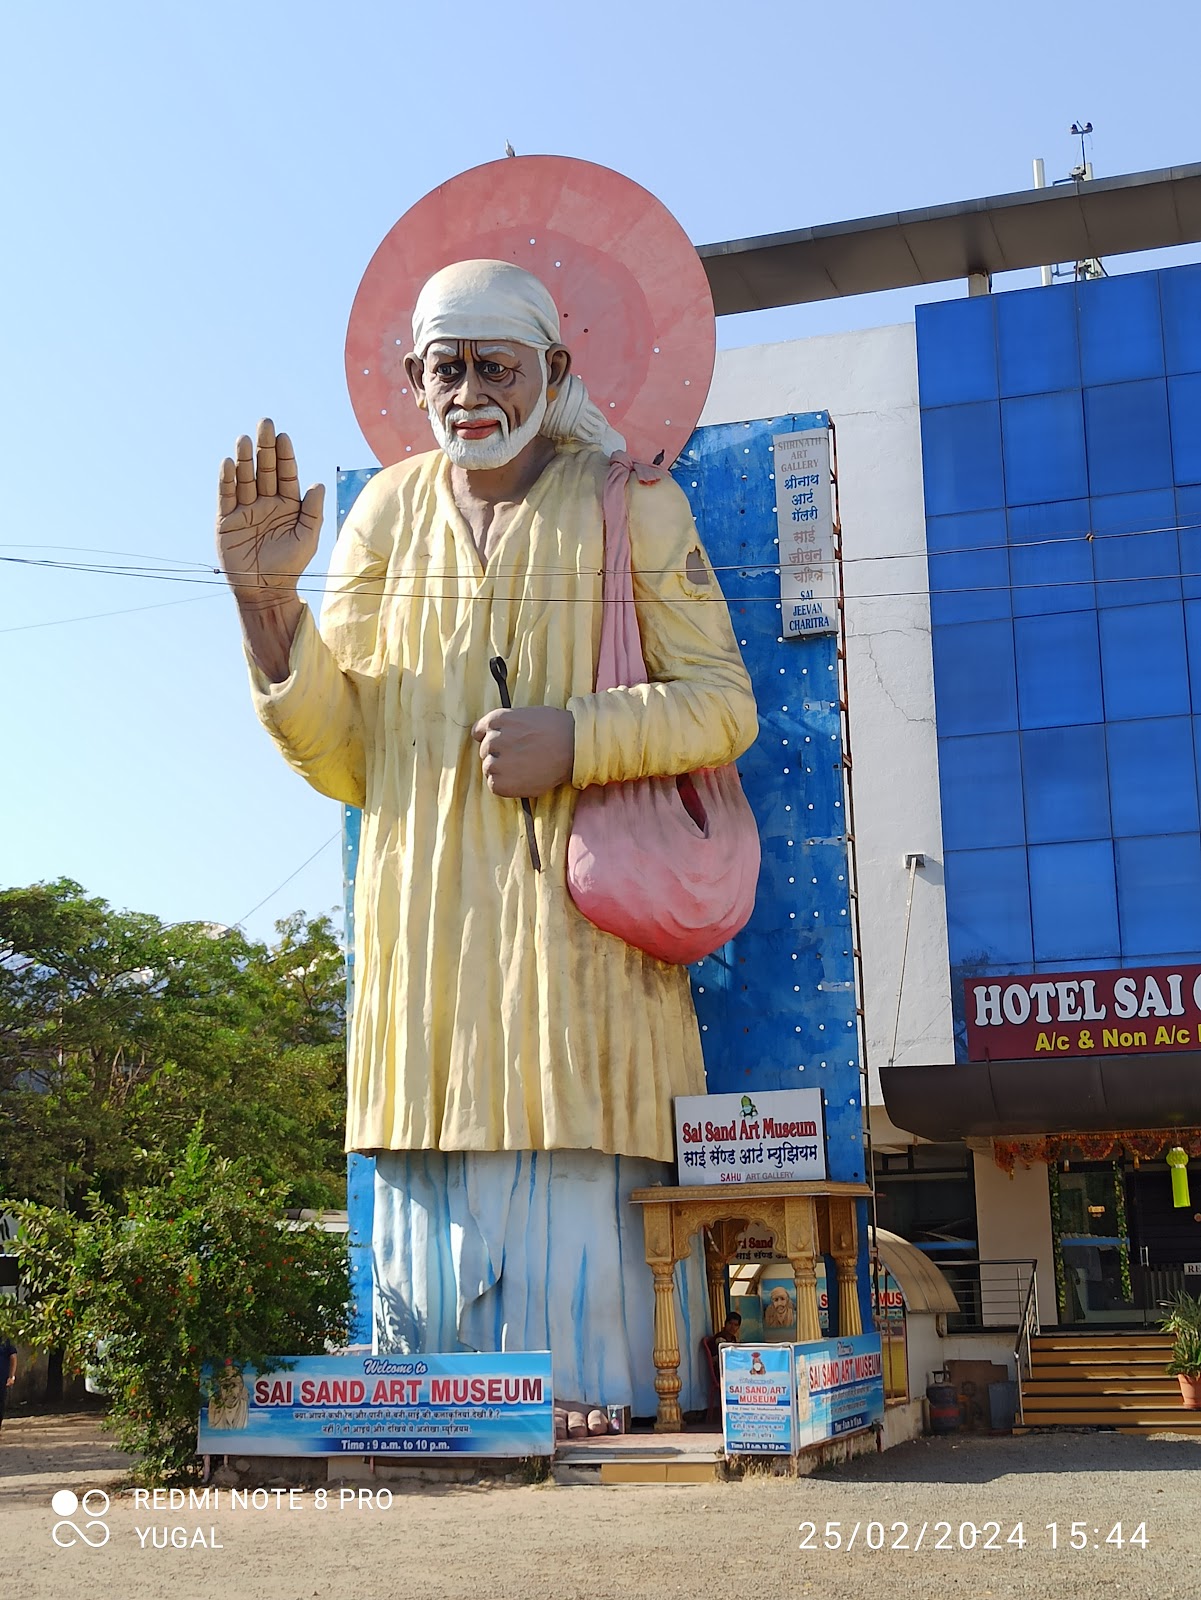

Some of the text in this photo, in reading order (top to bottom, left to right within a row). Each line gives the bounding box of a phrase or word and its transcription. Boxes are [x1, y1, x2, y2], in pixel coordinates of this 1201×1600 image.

[778, 437, 821, 451] SHRINATH
[791, 450, 808, 460] ART
[781, 459, 819, 472] GALLERY
[784, 474, 820, 490] श्रीनाथ
[791, 488, 814, 506] आर्ट
[793, 525, 816, 544] साई
[788, 548, 822, 564] जीवन
[800, 589, 814, 601] SAI
[793, 602, 823, 617] JEEVAN
[789, 616, 830, 631] CHARITRA
[973, 979, 1106, 1026] HOTEL
[1113, 974, 1185, 1019] SAI
[1034, 1031, 1070, 1051] A/c
[1077, 1029, 1095, 1049] &
[1102, 1028, 1147, 1048] Non
[1154, 1025, 1190, 1045] A/c
[683, 1118, 817, 1143] Sai Sand Art Museum
[683, 1145, 707, 1168] साई
[740, 1142, 763, 1164] आर्ट
[767, 1141, 818, 1168] म्युझियम
[720, 1171, 795, 1182] SAHU ART GALLERY
[749, 1236, 774, 1249] Sand
[363, 1359, 427, 1374] Welcome to
[808, 1353, 881, 1390] SAI SAND ART MUSEUM
[255, 1379, 542, 1404] SAI SAND ART MUSEUM
[729, 1386, 787, 1394] SAI SAND ART
[740, 1395, 777, 1403] MUSEUM
[341, 1440, 365, 1450] Time
[372, 1440, 379, 1450] 9
[381, 1441, 401, 1450] a.m.
[403, 1440, 413, 1450] to
[415, 1440, 427, 1450] 10
[430, 1441, 450, 1452] p.m.
